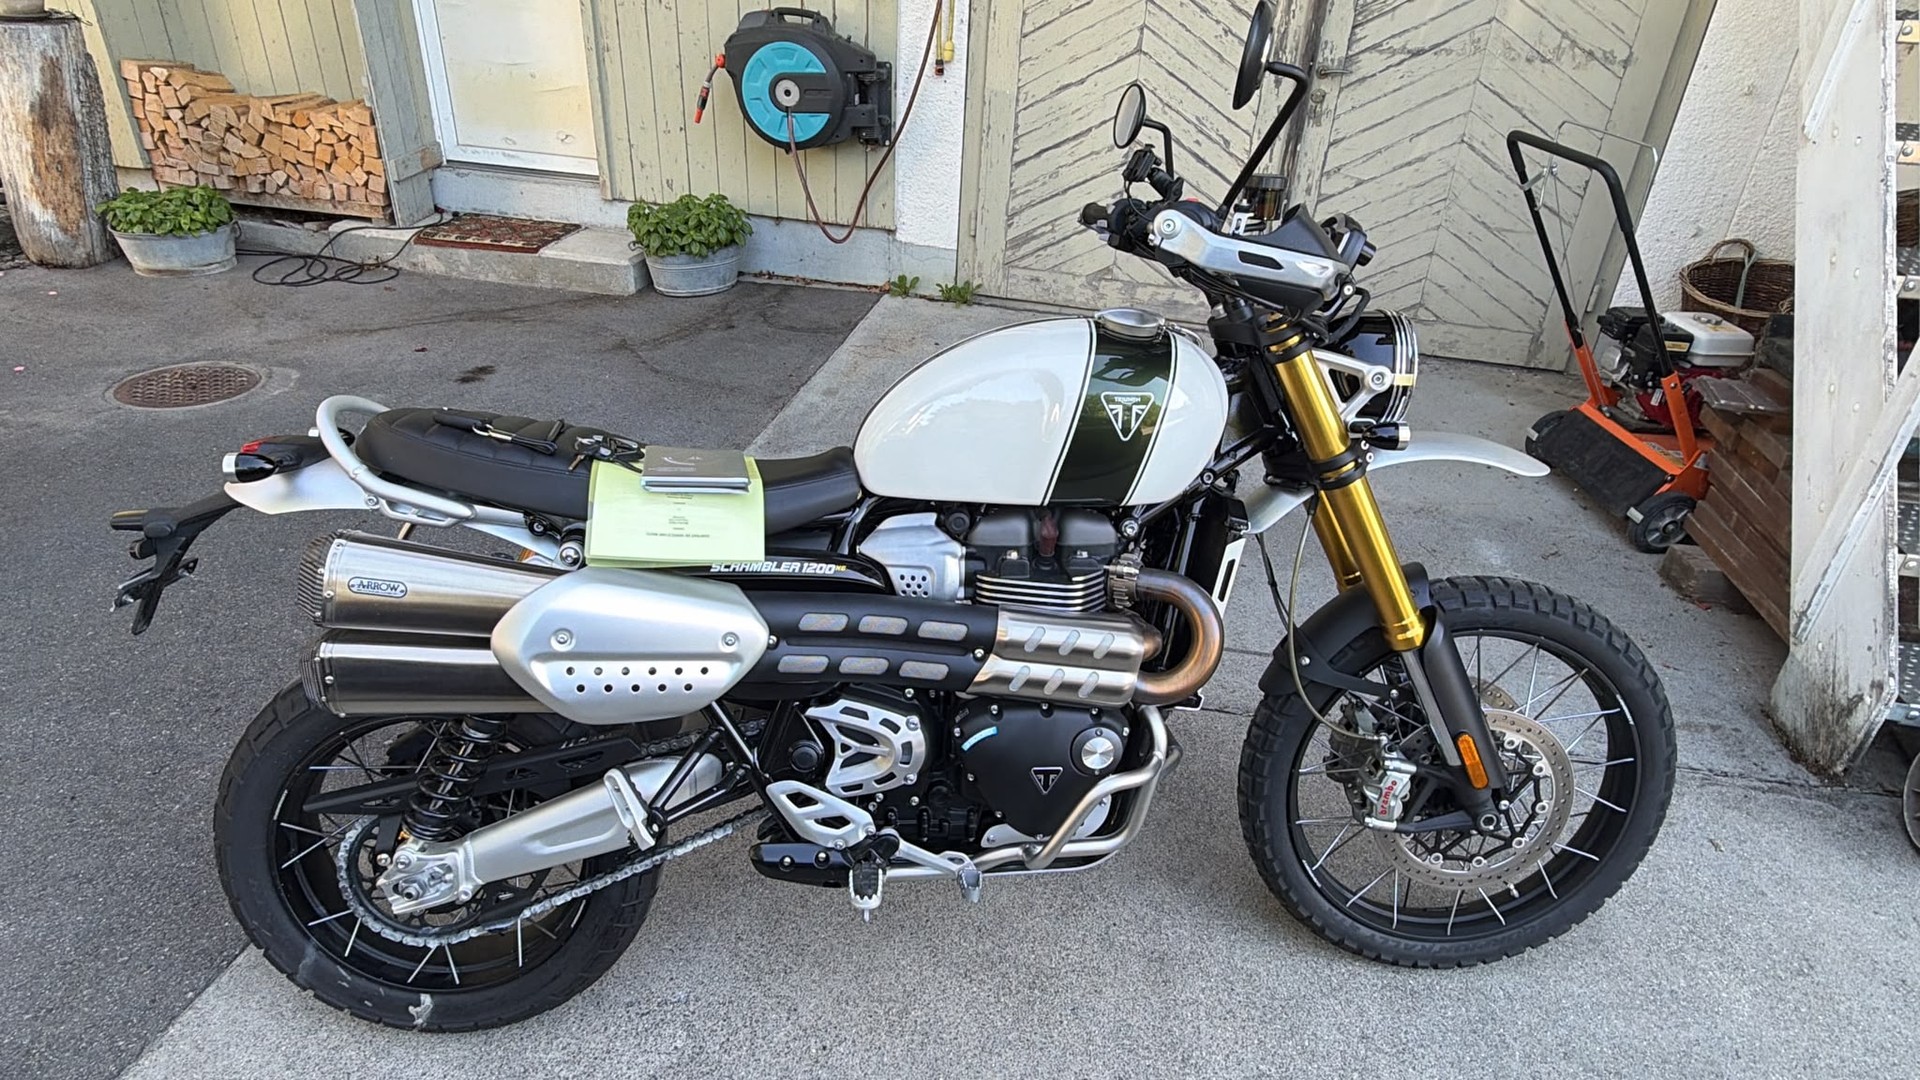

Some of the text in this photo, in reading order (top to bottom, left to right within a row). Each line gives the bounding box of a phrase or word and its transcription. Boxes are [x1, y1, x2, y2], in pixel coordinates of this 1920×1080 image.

[802, 562, 836, 574] 1200
[357, 580, 400, 591] ARROW
[1378, 780, 1397, 816] brembo
